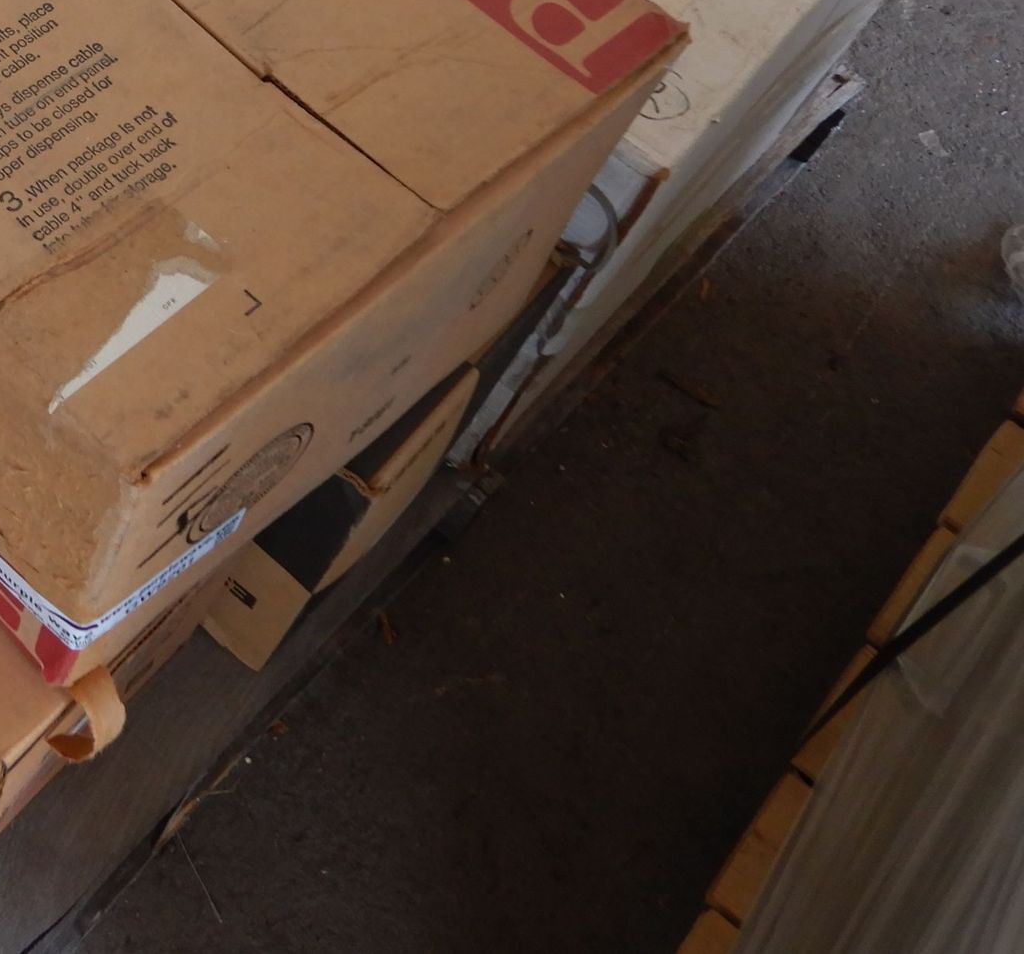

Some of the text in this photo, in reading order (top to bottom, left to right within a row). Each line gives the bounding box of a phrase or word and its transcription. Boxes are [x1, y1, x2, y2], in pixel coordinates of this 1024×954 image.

[8, 18, 59, 56] position
[18, 1, 55, 30] place
[4, 106, 37, 130] tube
[36, 94, 55, 111] on
[54, 82, 80, 100] end
[11, 65, 70, 107] dispense
[68, 40, 104, 69] cable
[20, 128, 35, 144] to
[34, 115, 54, 134] be
[52, 89, 97, 124] closed
[92, 74, 114, 94] for
[25, 168, 70, 202] When
[68, 130, 123, 175] package
[133, 104, 159, 124] not
[63, 160, 110, 198] double
[111, 143, 139, 167] over
[136, 124, 163, 147] end
[161, 110, 178, 130] of
[32, 210, 72, 242] cable
[88, 178, 116, 202] and
[113, 157, 142, 188] tuck
[140, 138, 178, 166] back
